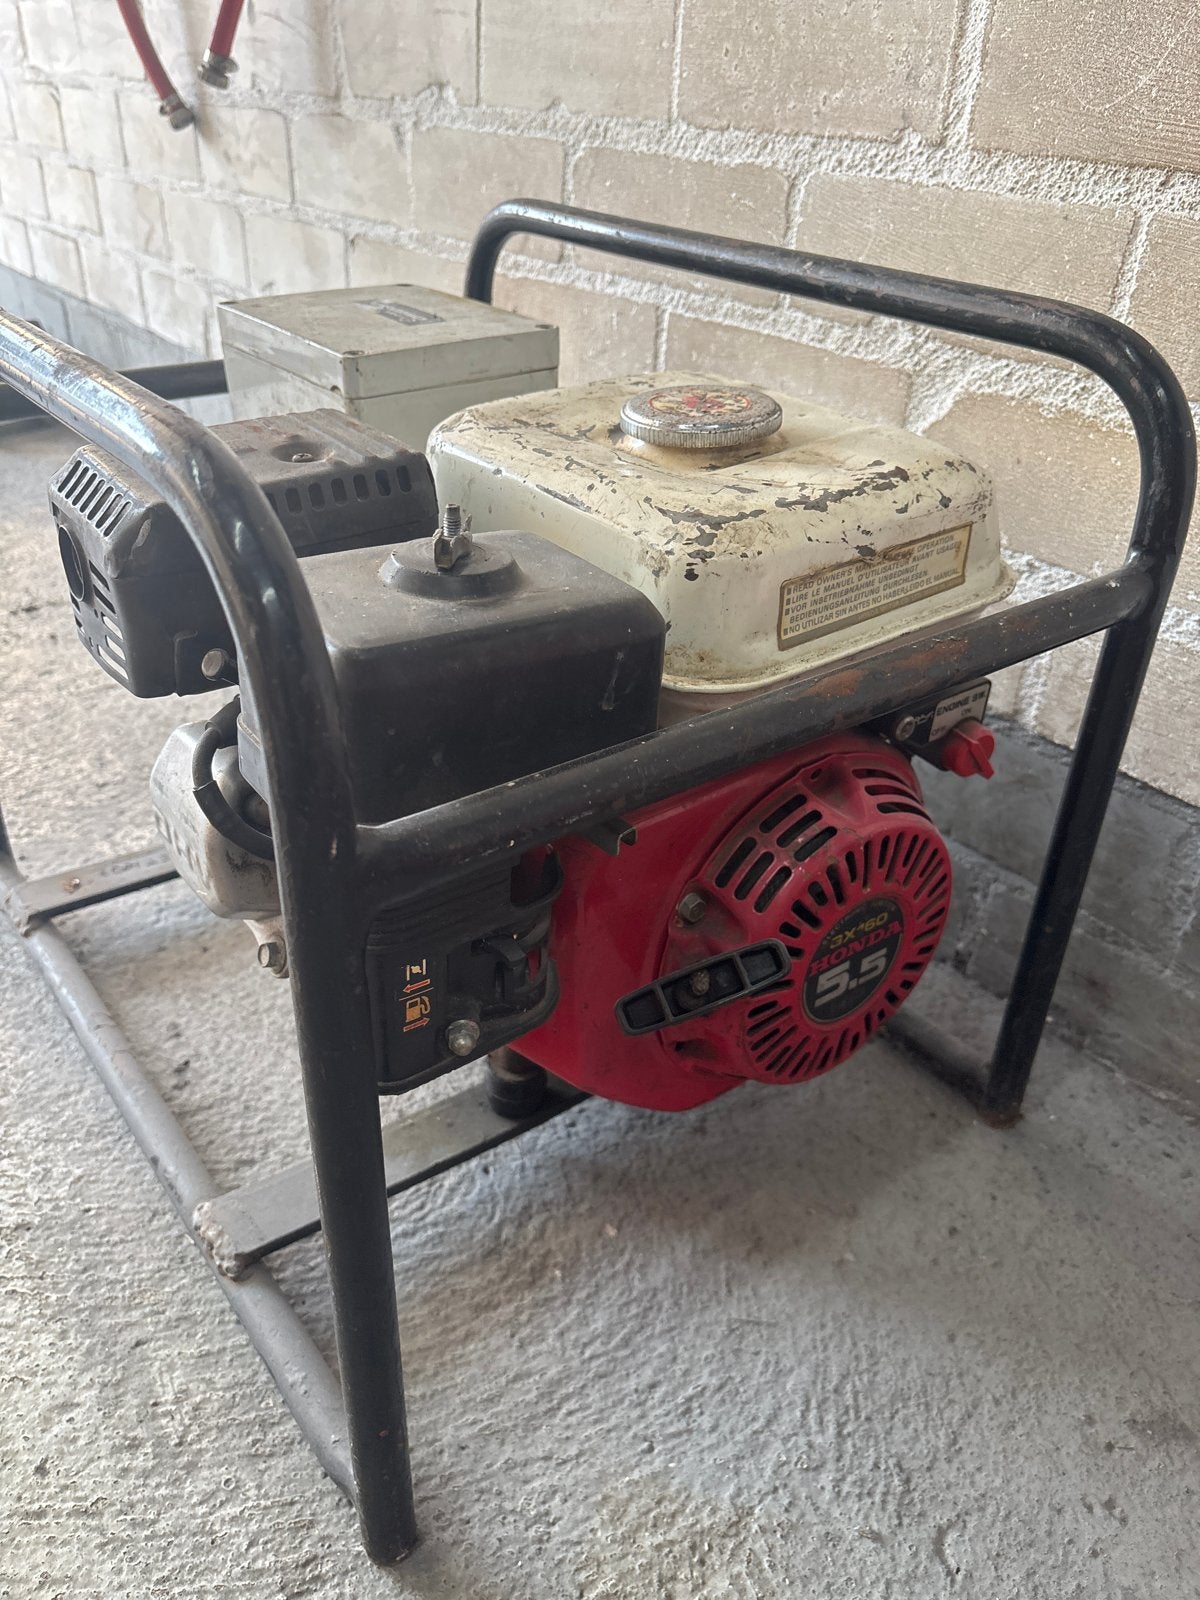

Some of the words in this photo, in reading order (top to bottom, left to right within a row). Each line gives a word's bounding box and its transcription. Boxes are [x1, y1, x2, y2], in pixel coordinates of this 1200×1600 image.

[791, 603, 807, 614] VOR
[810, 579, 875, 607] INBETRIEBNAHME
[878, 563, 919, 583] UNBEDINGT
[792, 592, 808, 604] LIRE
[812, 588, 820, 597] LE
[823, 577, 854, 593] MANUEL
[912, 549, 934, 564] AVANT
[793, 581, 814, 593] READ
[817, 568, 852, 586] OWNER'S
[917, 535, 954, 552] OPERATION
[789, 624, 801, 634] NO
[801, 613, 833, 629] UTILIZAR
[835, 607, 847, 618] SIN
[848, 599, 871, 613] ANTES
[871, 596, 882, 605] NO
[926, 577, 932, 586] EL
[933, 568, 959, 581] MANUAL
[790, 586, 880, 624] BEDIENUNGSANLEITUNG
[936, 696, 969, 716] ENGINE
[809, 921, 903, 977] HONDA
[814, 947, 888, 1008] 5.5
